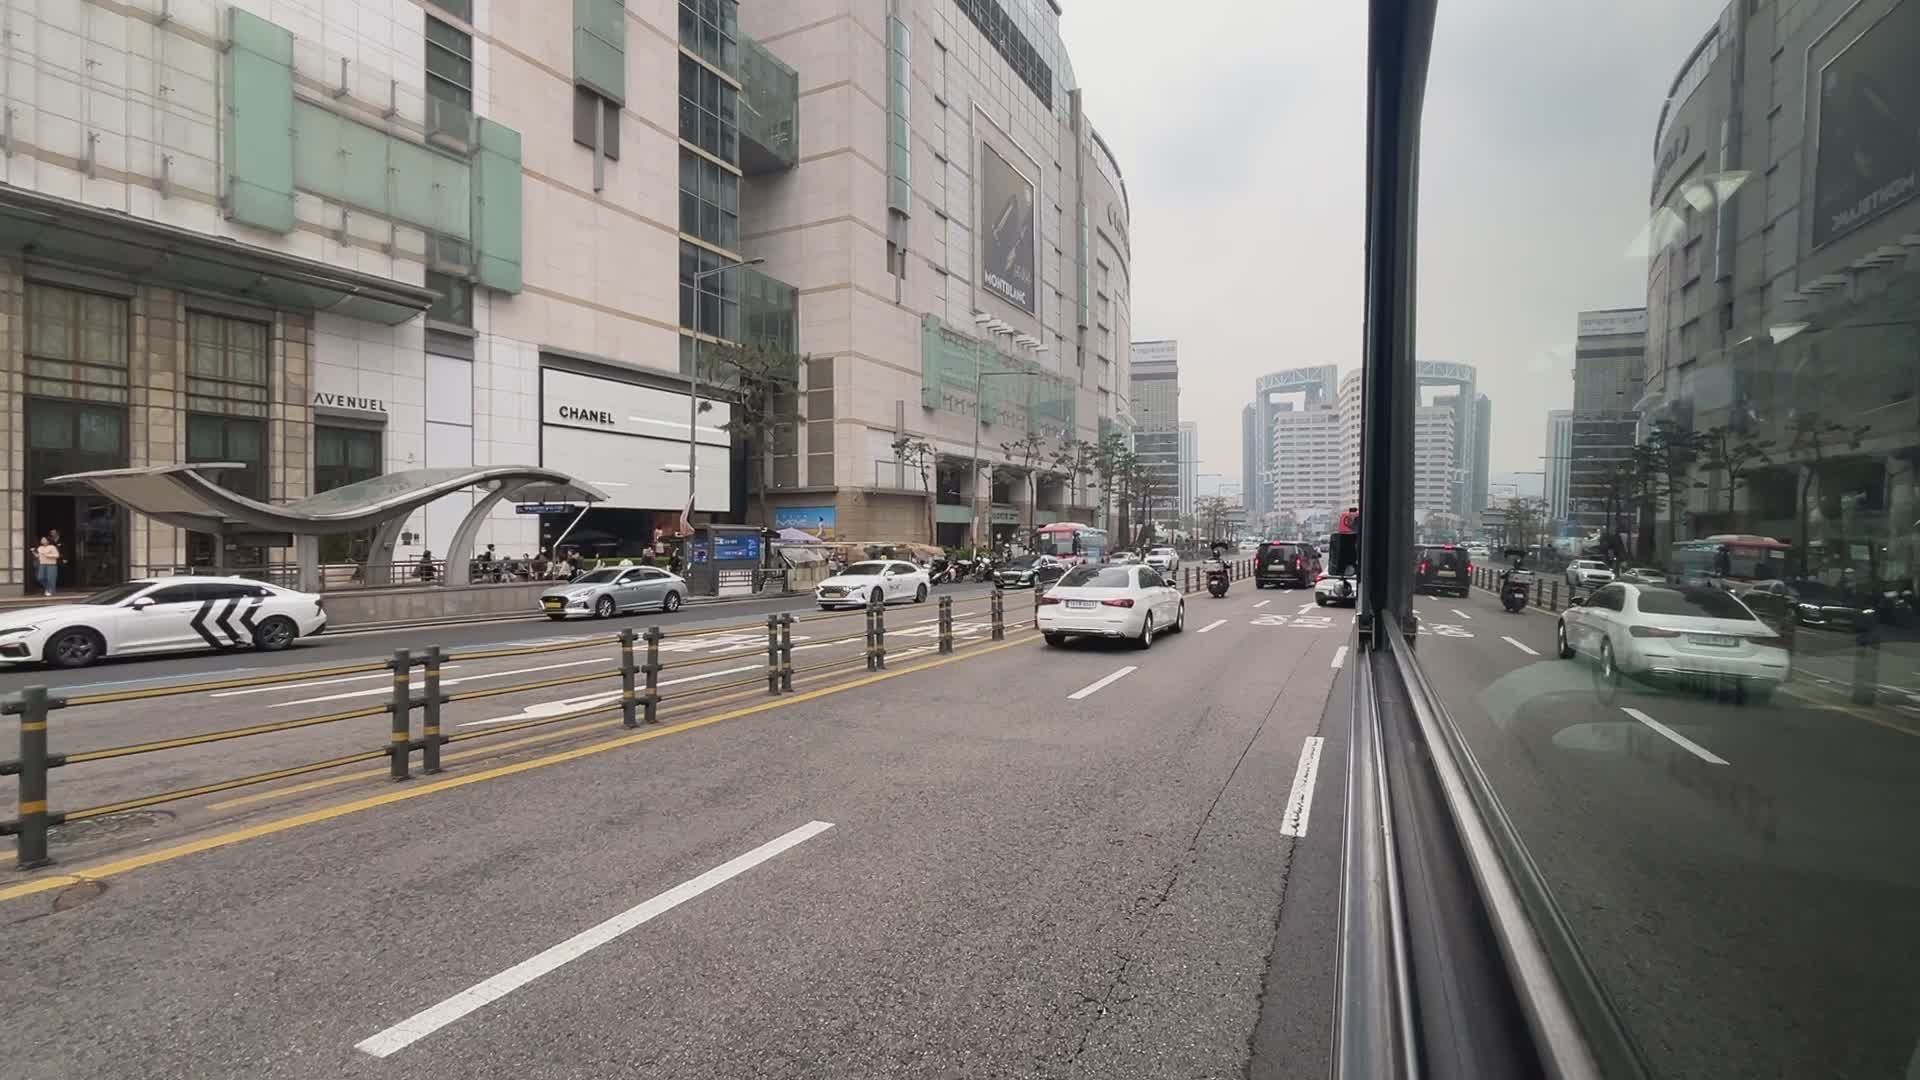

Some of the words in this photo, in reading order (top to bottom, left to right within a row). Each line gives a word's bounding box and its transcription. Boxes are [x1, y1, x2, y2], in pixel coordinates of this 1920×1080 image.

[985, 271, 1026, 305] MONTBLANC
[314, 392, 387, 412] AVENUEL
[559, 405, 615, 425] CHANEL
